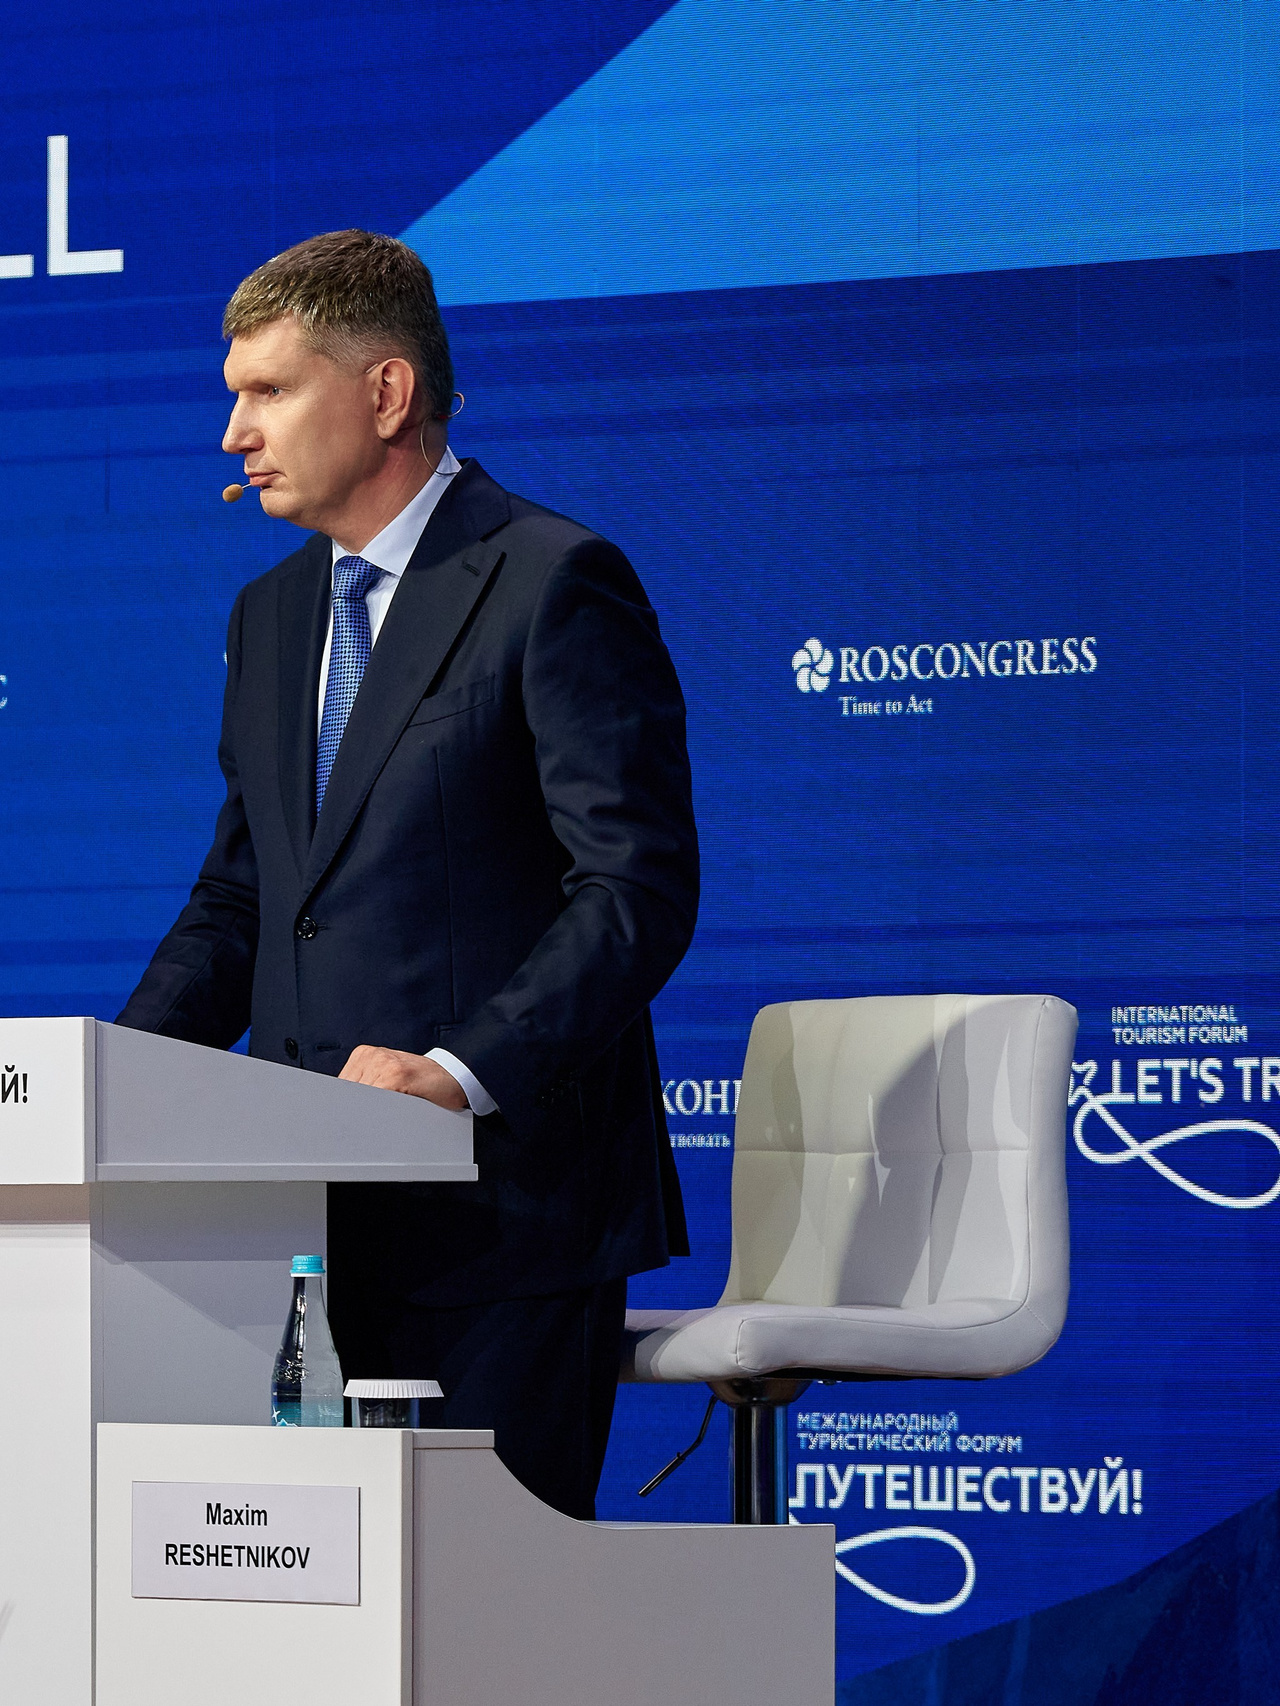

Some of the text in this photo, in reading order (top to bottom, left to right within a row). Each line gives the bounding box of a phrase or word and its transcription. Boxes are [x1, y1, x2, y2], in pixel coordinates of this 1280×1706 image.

[839, 636, 1098, 683] ROSCONGRESS
[838, 693, 933, 716] Time to Act
[1111, 1005, 1237, 1024] INTERNATIONAL
[1111, 1025, 1248, 1044] TOURISM FORUM
[1110, 1058, 1225, 1104] LET'S
[955, 1435, 1023, 1453] ФОРУМ
[789, 1456, 1143, 1515] ПУТЕШЕСТВУЙ!
[206, 1502, 269, 1527] Maxim
[164, 1542, 311, 1570] RESHETNIKOV
